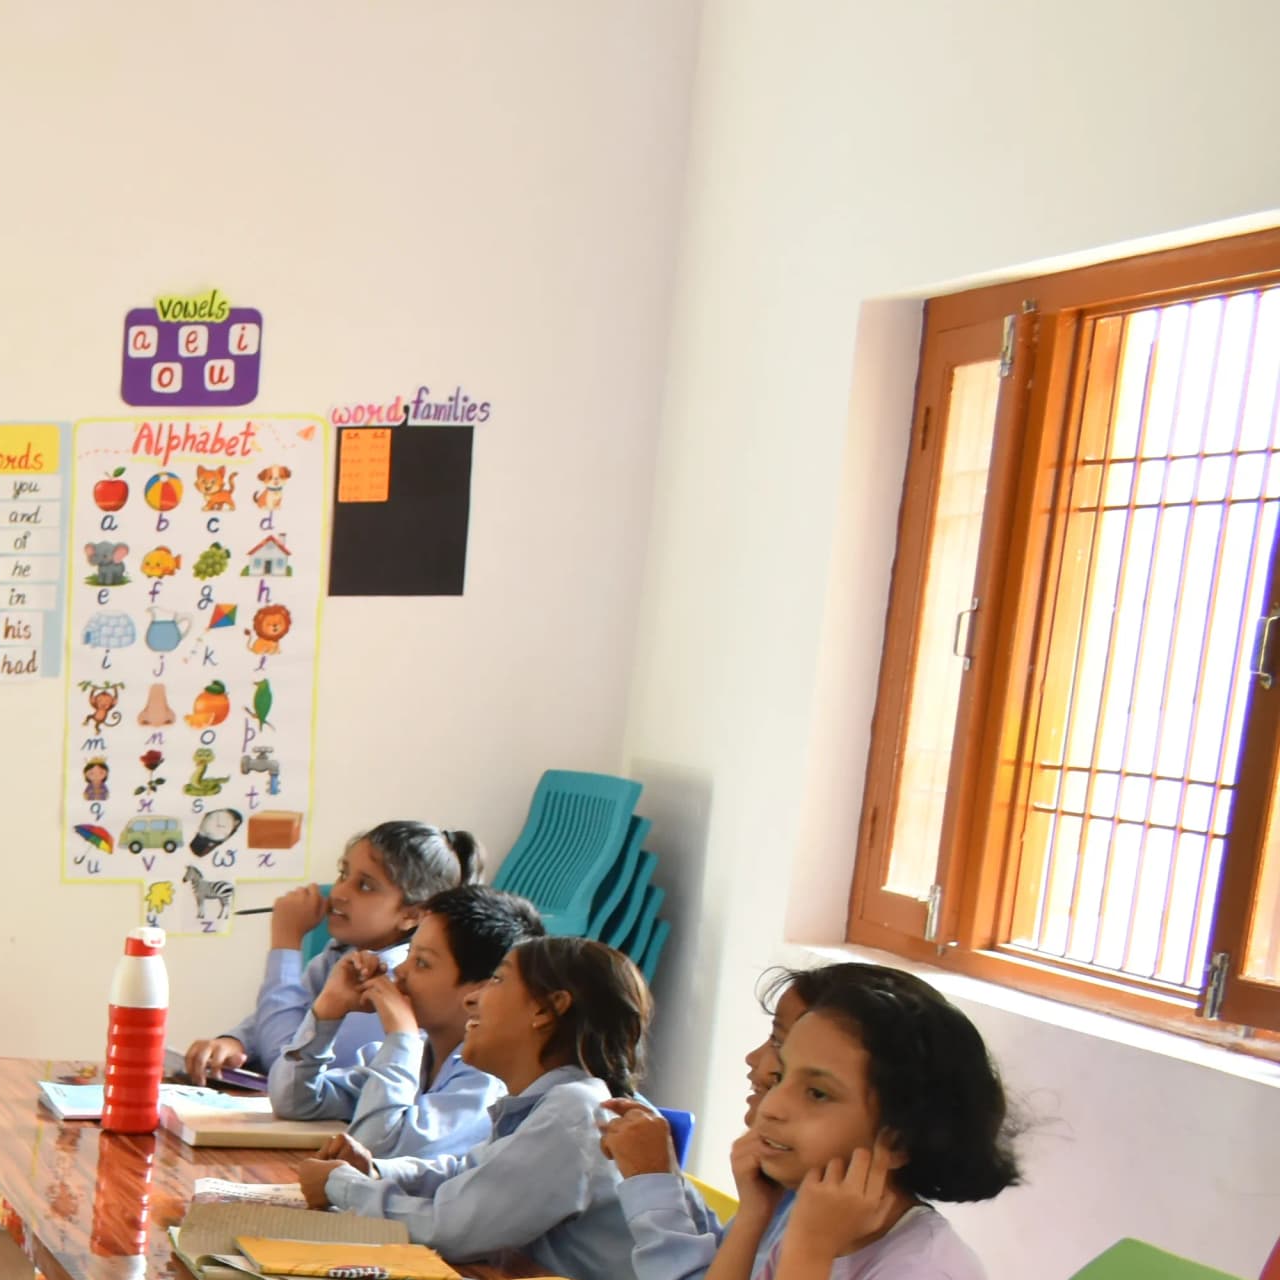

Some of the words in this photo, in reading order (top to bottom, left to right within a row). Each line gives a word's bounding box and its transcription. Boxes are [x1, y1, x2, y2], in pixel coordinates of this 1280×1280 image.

[159, 289, 228, 319] vowels
[132, 330, 151, 350] a
[185, 330, 198, 353] e
[237, 325, 248, 351] i
[157, 366, 174, 388] o
[208, 364, 229, 385] u
[331, 395, 404, 425] word
[411, 386, 491, 423] families
[132, 421, 256, 467] Alphabet
[12, 480, 40, 501] you
[9, 505, 42, 525] and
[100, 514, 118, 531] a
[156, 512, 170, 532] b
[207, 517, 220, 533] c
[260, 511, 274, 530] d
[11, 560, 31, 577] he
[8, 588, 27, 606] in
[97, 588, 110, 605] e
[148, 581, 163, 603] f
[197, 585, 213, 610] g
[257, 579, 271, 603] h
[3, 616, 32, 640] his
[0, 649, 38, 675] had
[101, 649, 112, 669] i
[152, 655, 165, 677] j
[202, 646, 218, 666] k
[83, 737, 106, 750] m
[145, 732, 165, 745] n
[200, 729, 216, 745] o
[241, 717, 256, 753] p
[192, 799, 204, 813] s
[245, 785, 260, 809] t
[89, 802, 104, 821] q
[87, 860, 101, 874] u
[258, 853, 276, 868] x
